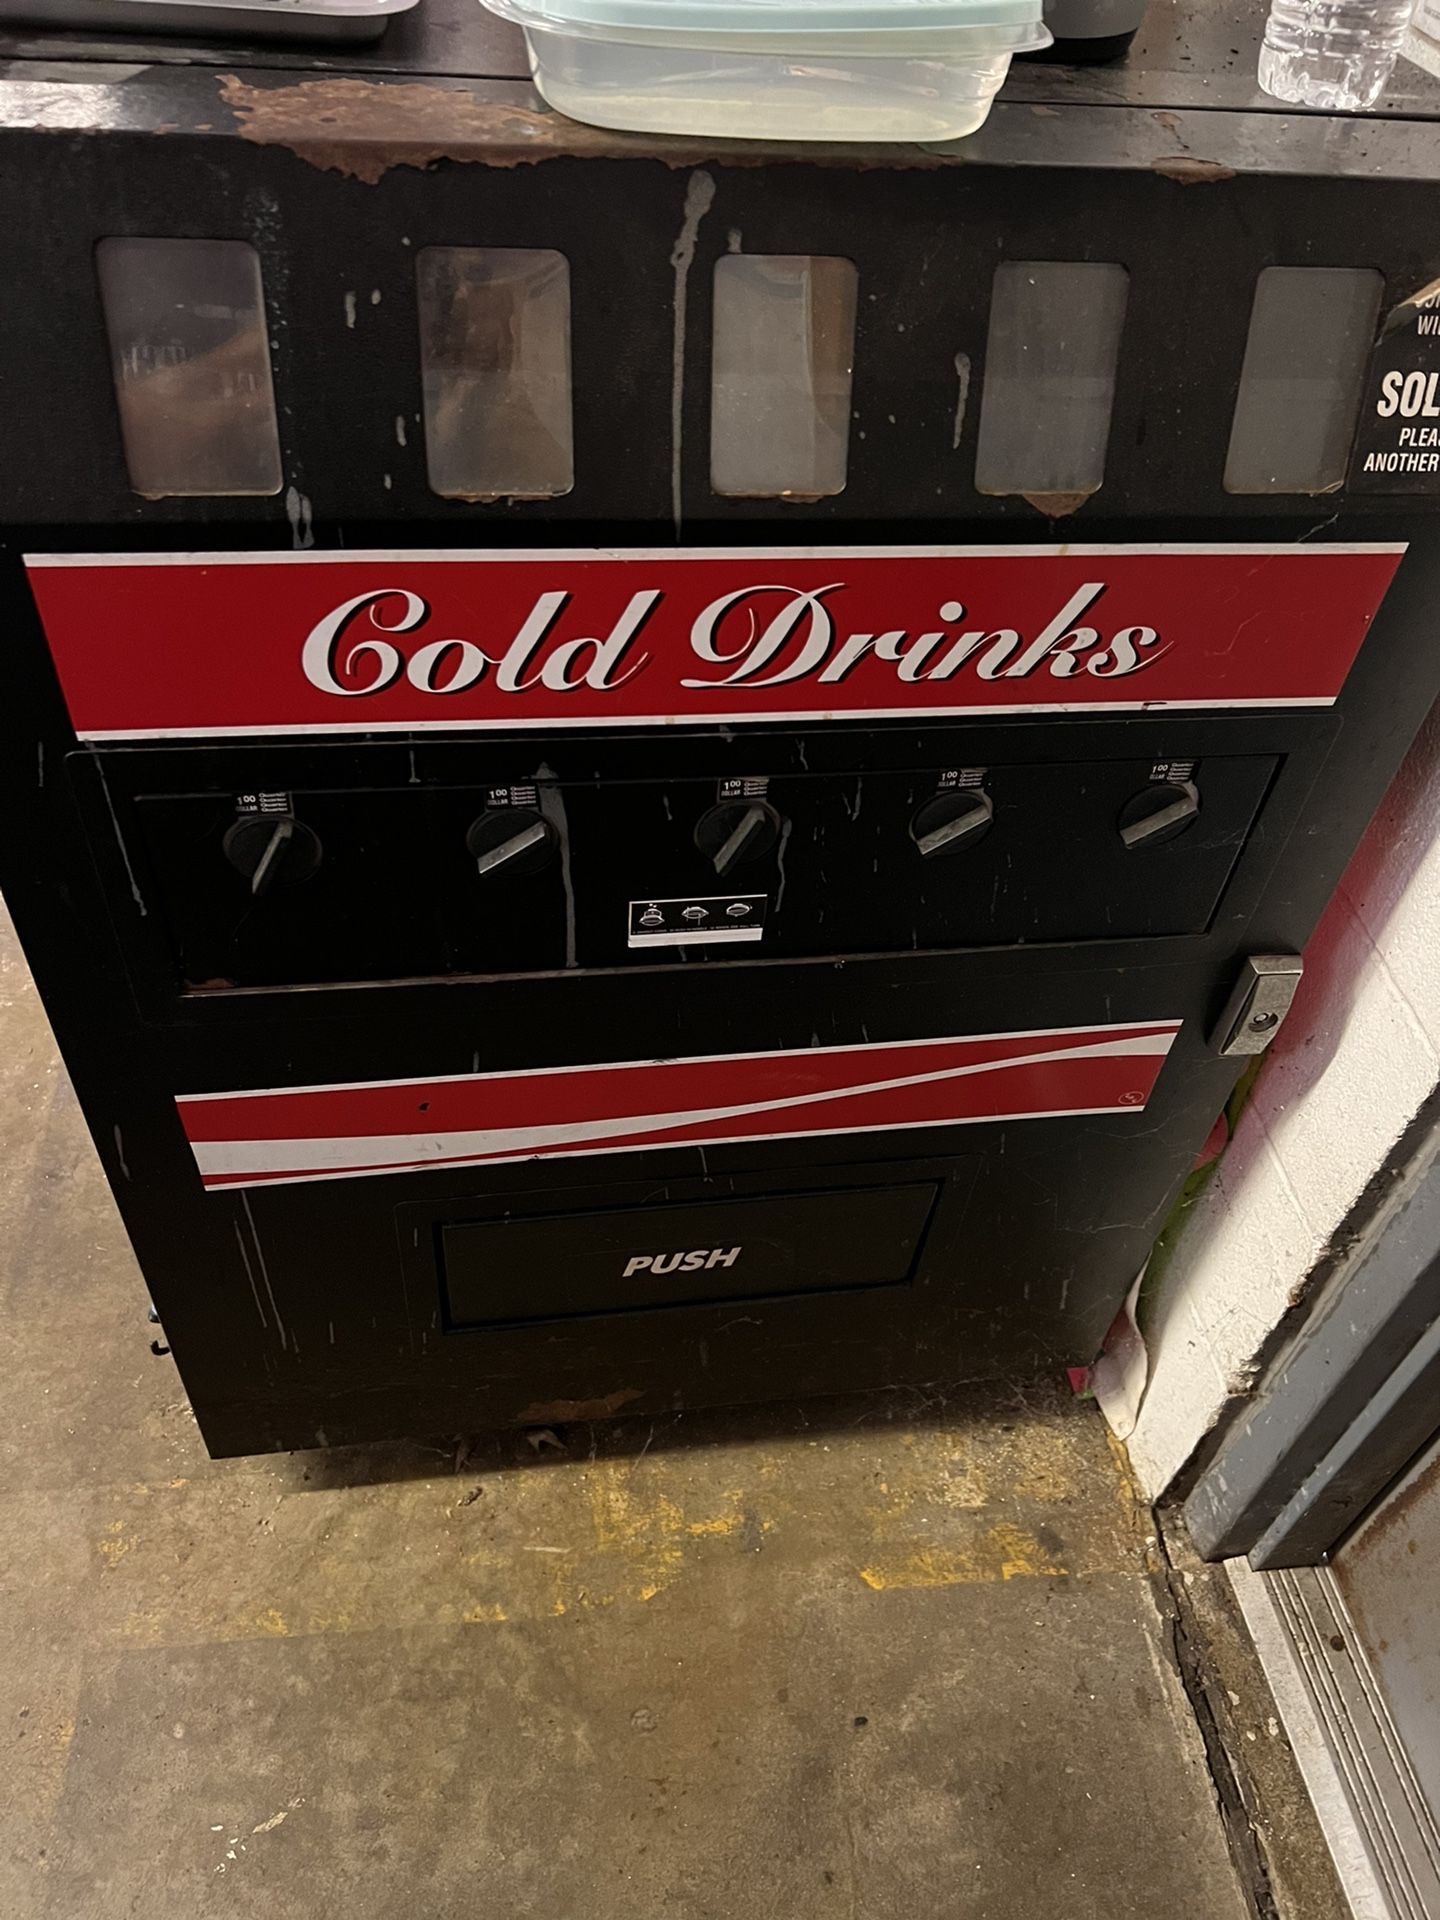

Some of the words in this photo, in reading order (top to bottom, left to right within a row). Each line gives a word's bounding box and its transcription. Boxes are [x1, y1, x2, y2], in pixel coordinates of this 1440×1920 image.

[1399, 428, 1440, 446] PLEA
[1363, 453, 1440, 472] ANOTHER
[302, 588, 662, 696] Cold
[680, 582, 1176, 687] Drinks
[622, 1247, 742, 1277] PUSH
